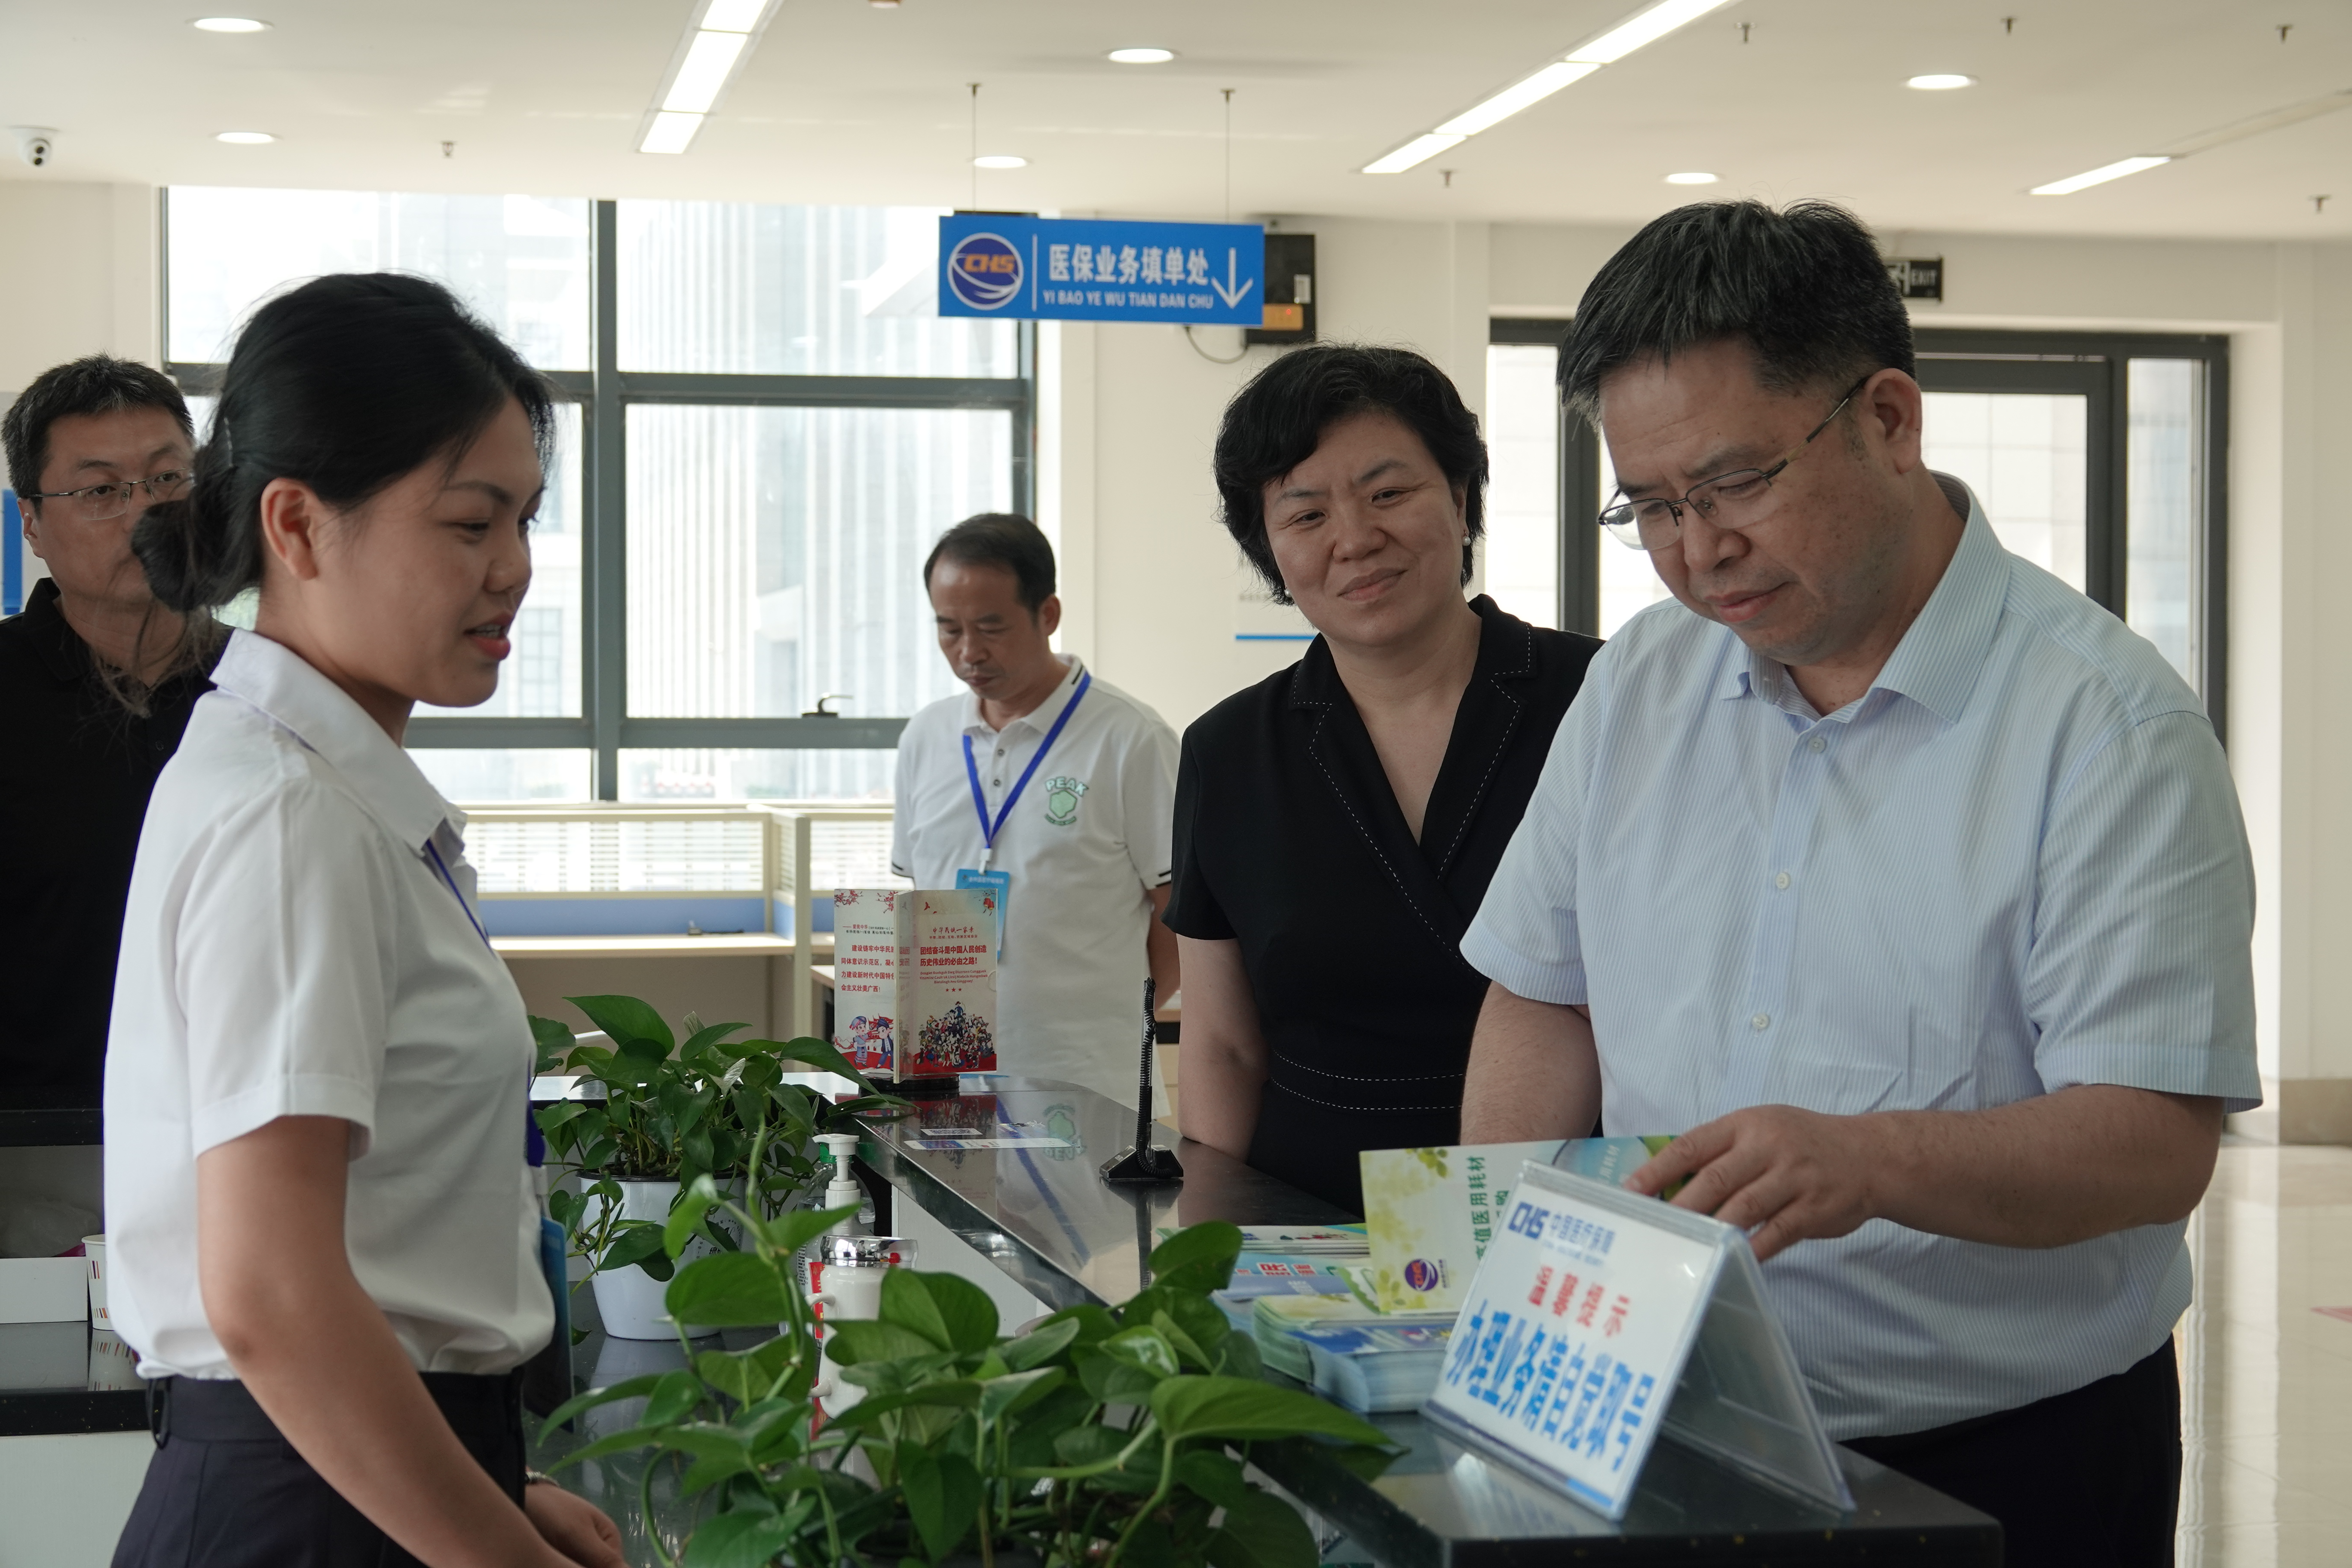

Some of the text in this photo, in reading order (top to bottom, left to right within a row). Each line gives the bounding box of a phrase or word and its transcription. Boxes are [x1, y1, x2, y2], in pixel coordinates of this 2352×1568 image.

[964, 254, 1015, 273] CHS
[1049, 243, 1209, 286] 医保业务填单处
[1043, 289, 1213, 309] YI BAO YE WU TIAN DAN CHU
[1045, 776, 1089, 797] PEAK
[920, 945, 987, 955] 团结奋斗是中国人民创造
[920, 957, 977, 967] 历史伟业的必由之路！
[1528, 1265, 1630, 1338] 温馨提示
[1446, 1299, 1655, 1472] 办理业务请自觉取号
